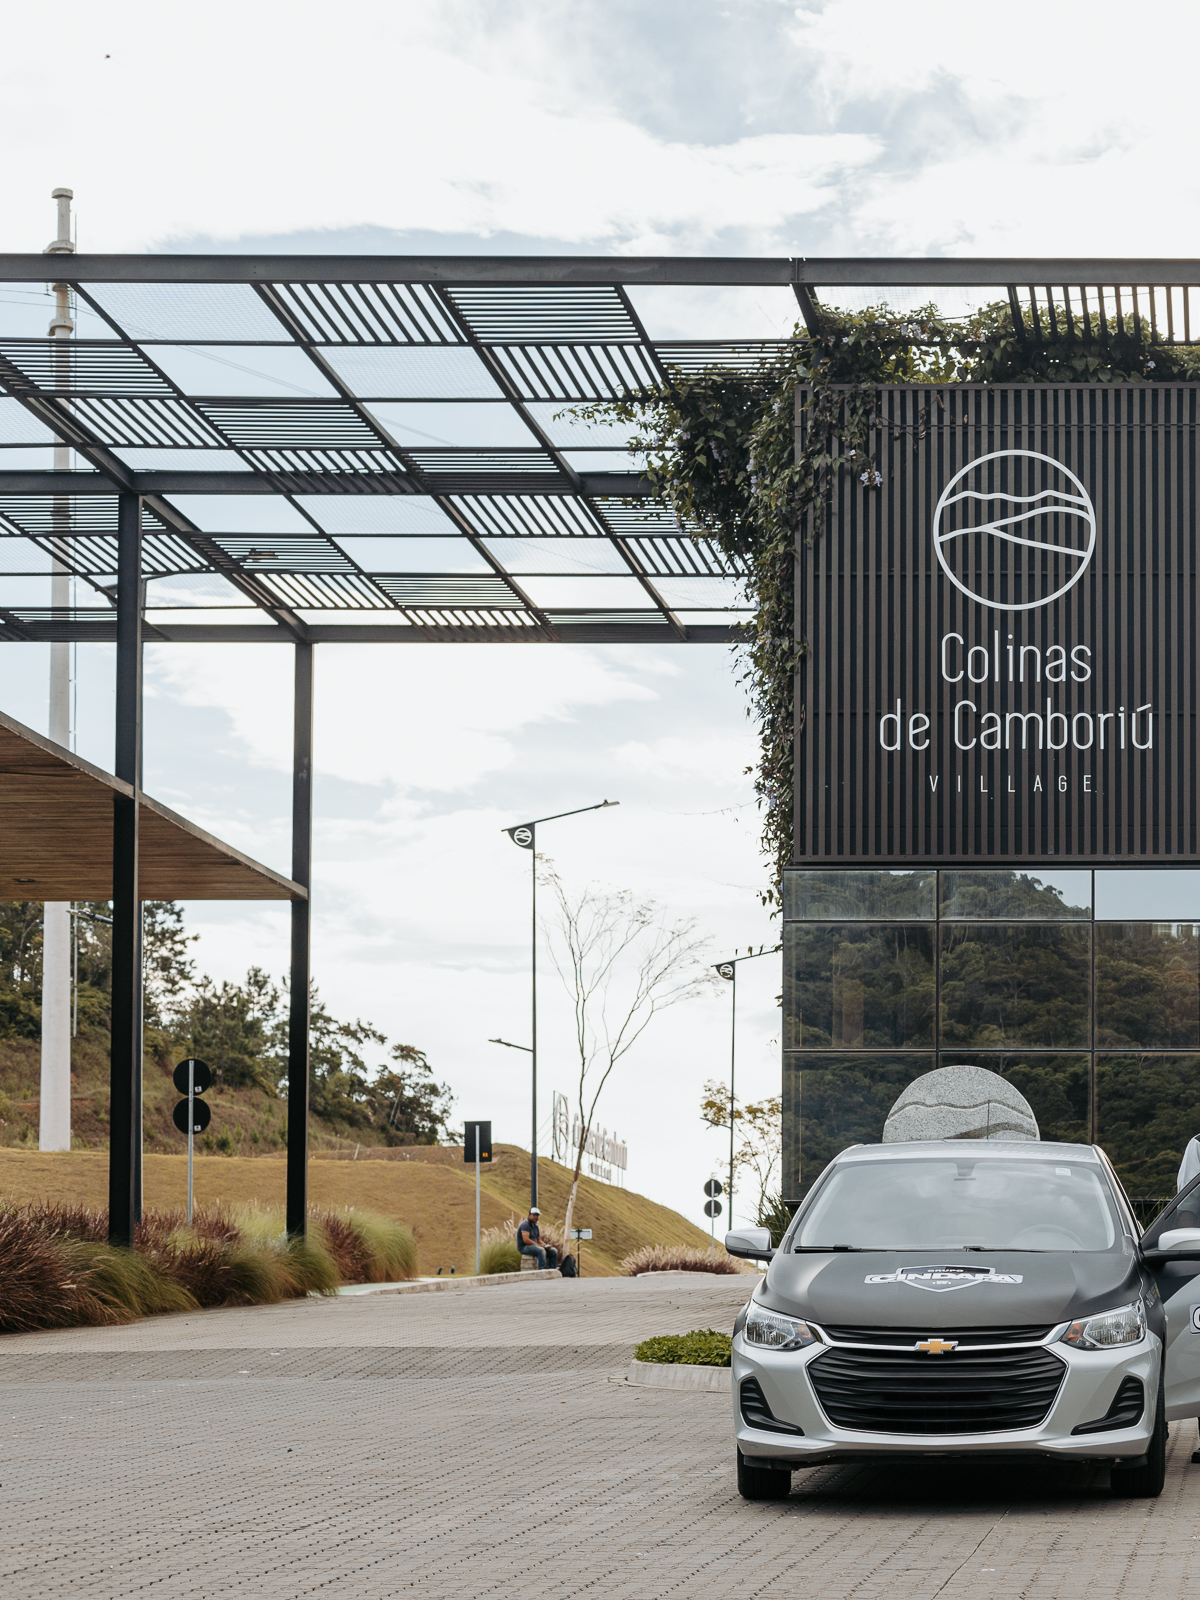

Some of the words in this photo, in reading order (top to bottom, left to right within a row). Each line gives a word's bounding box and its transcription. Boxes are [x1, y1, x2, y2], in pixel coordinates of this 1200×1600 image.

[941, 630, 1092, 683] Colinas
[879, 698, 930, 751] de
[954, 697, 1153, 751] Camboriú
[929, 774, 1093, 793] VILLAGE
[870, 1273, 1016, 1283] CINDAPA
